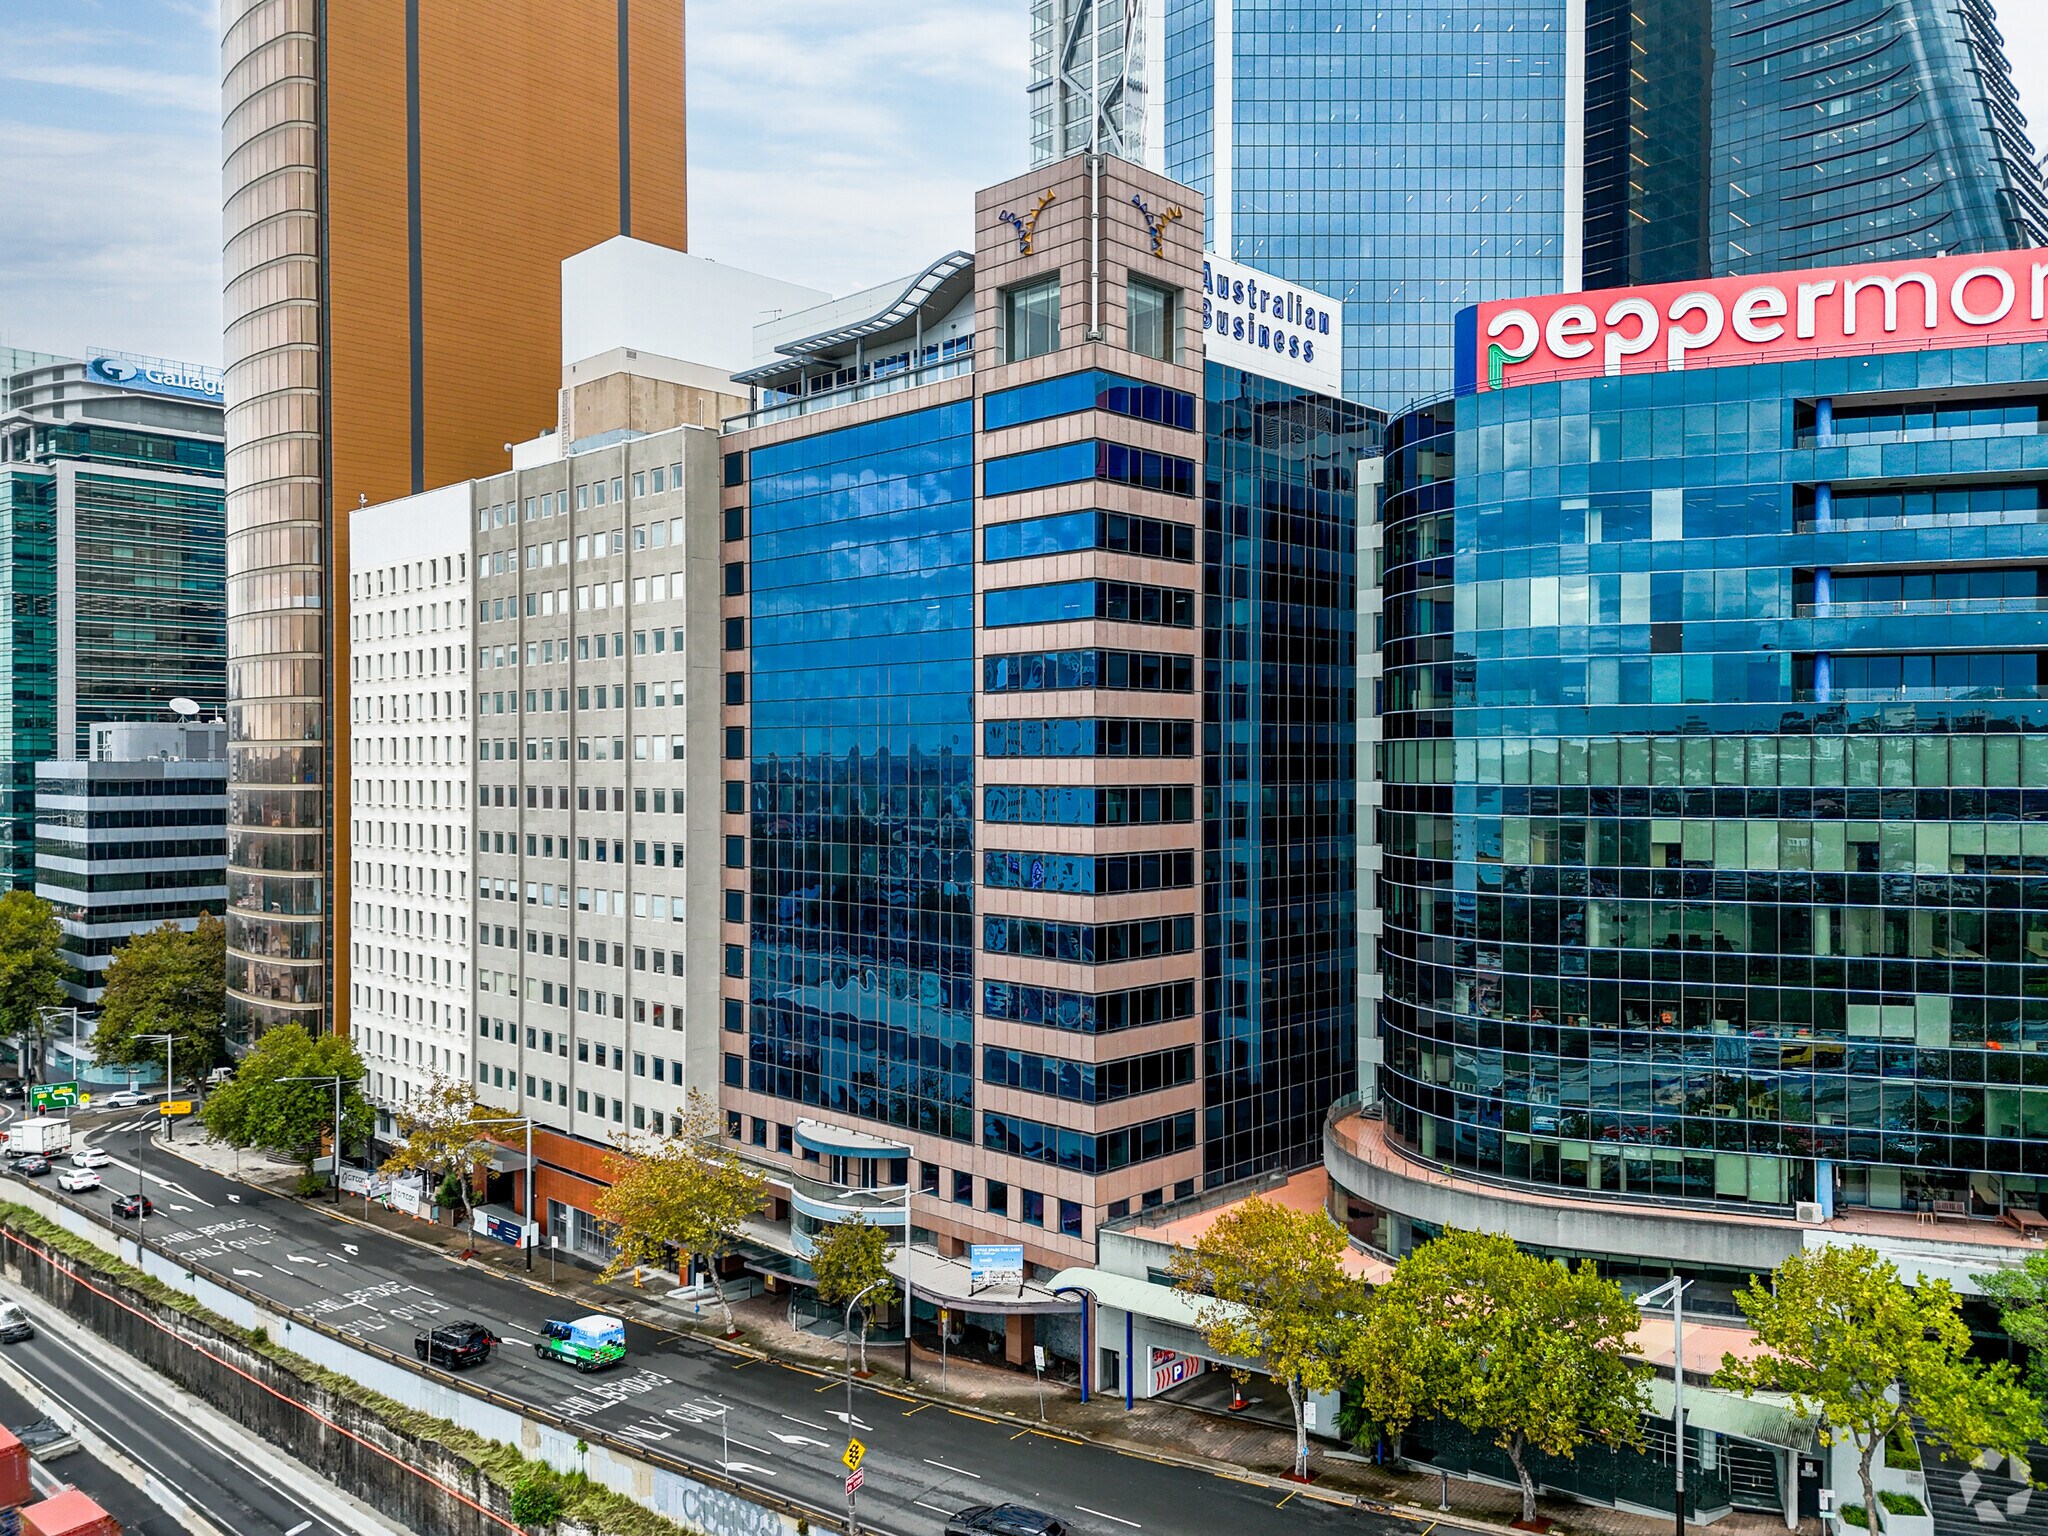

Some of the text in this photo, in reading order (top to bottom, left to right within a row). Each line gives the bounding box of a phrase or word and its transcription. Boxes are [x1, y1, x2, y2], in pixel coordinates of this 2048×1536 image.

[1204, 261, 1330, 335] Australian
[1204, 297, 1314, 363] Business
[1174, 1365, 1182, 1380] P
